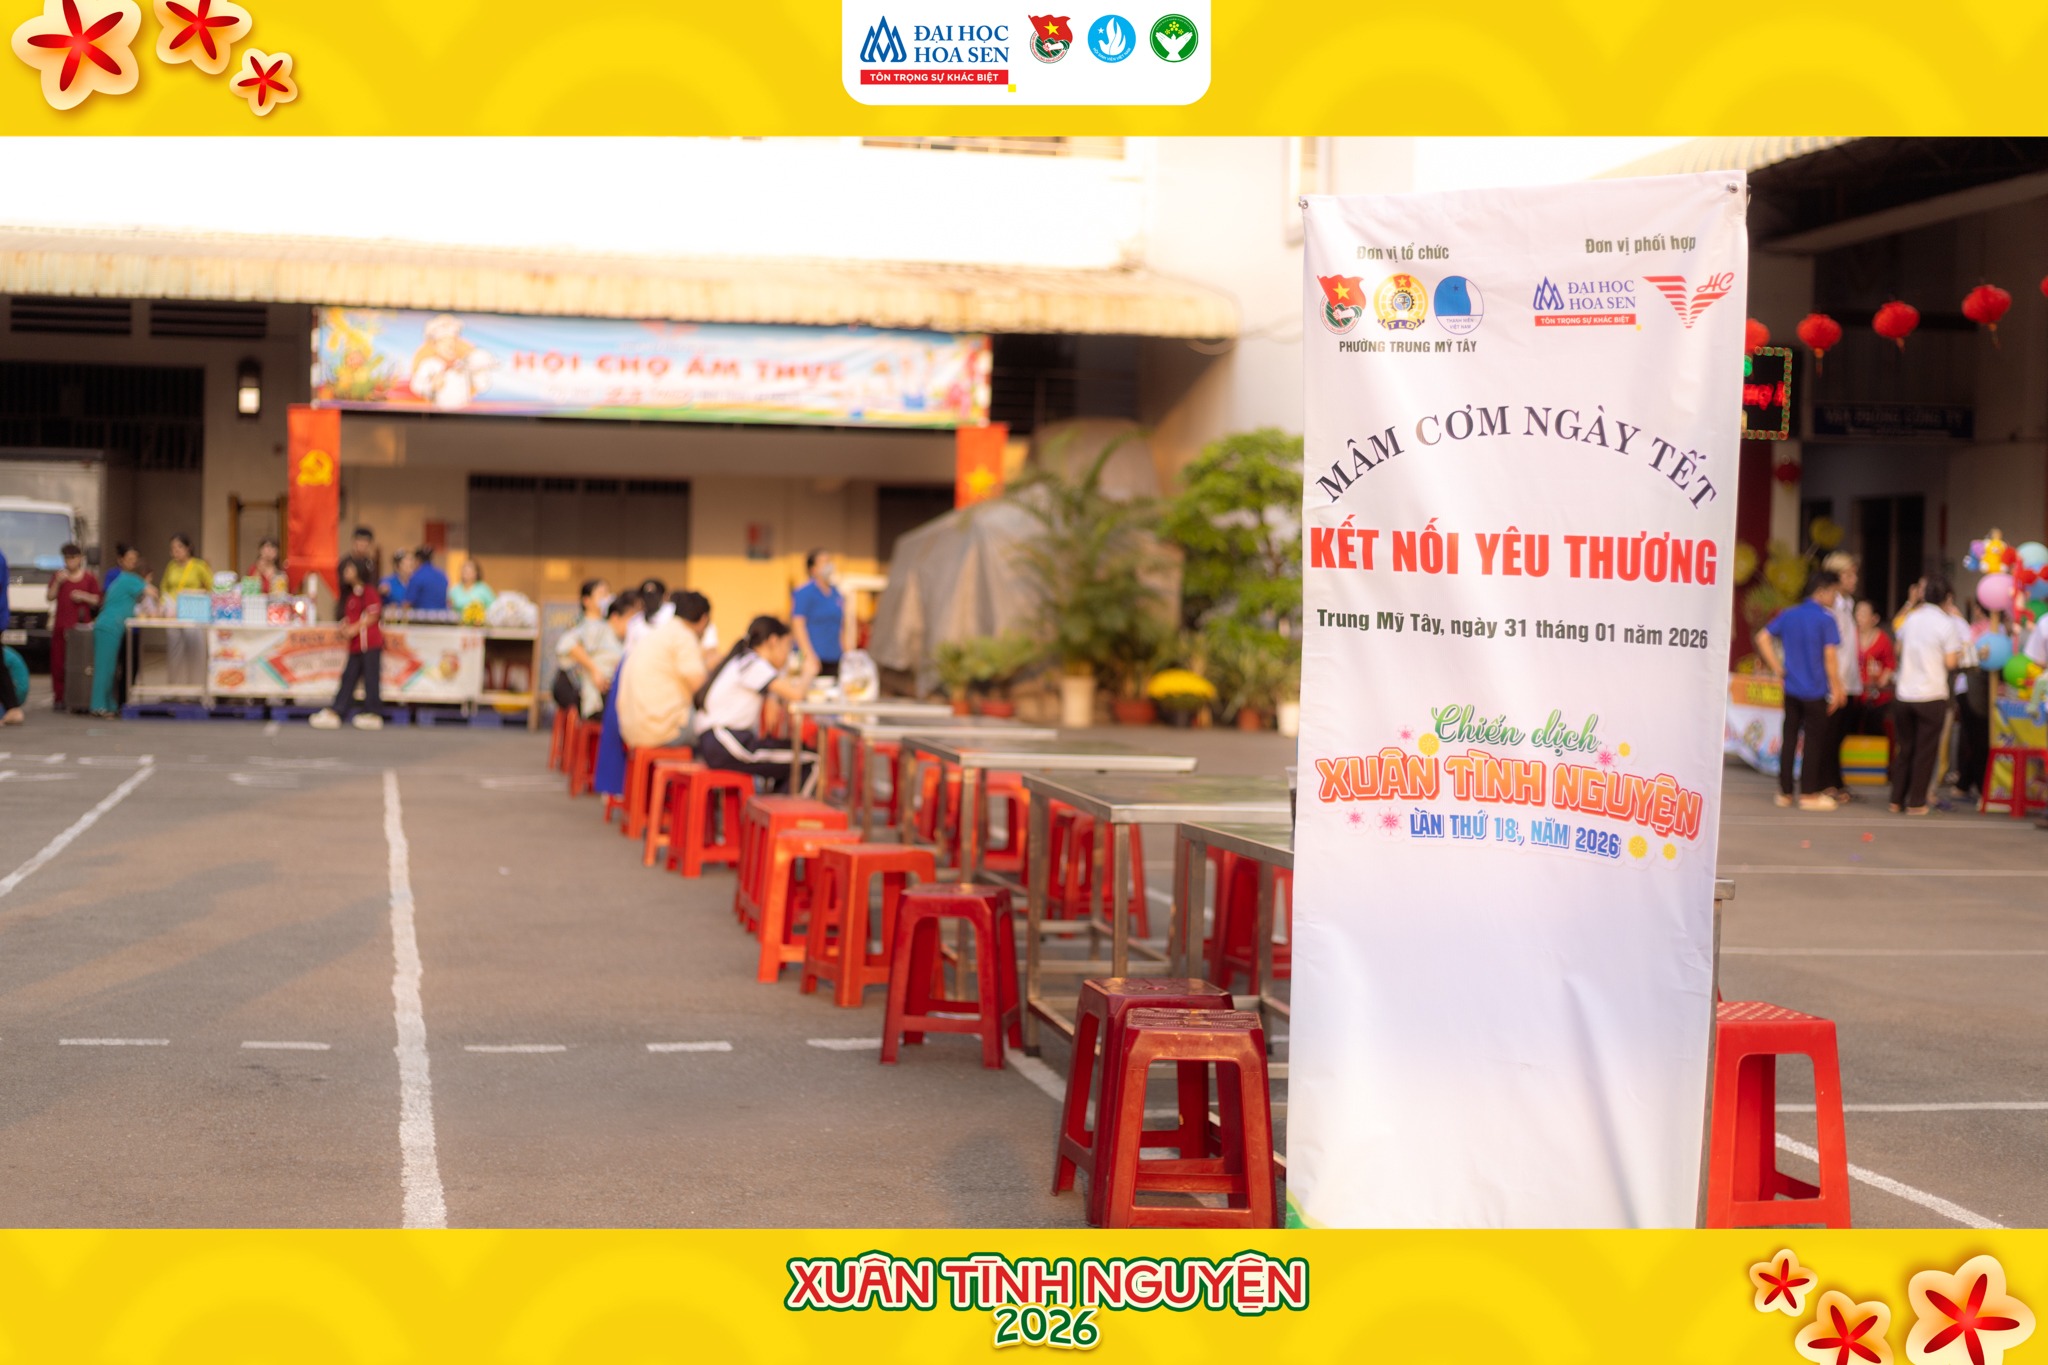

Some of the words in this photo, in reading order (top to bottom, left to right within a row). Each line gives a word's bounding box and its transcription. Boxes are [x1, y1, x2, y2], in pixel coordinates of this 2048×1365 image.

[1356, 245, 1383, 260] Đơn
[1386, 245, 1398, 263] vị
[1401, 242, 1415, 260] tổ
[1418, 244, 1450, 260] chức
[1585, 238, 1613, 253] Đơn
[1617, 237, 1630, 255] vị
[1634, 233, 1666, 254] phối
[1670, 235, 1696, 254] hợp
[1568, 281, 1594, 296] ĐẠI
[1599, 280, 1635, 295] HỌC
[1696, 272, 1735, 293] HC
[1569, 297, 1605, 310] HOA
[1607, 296, 1636, 309] SEN
[1540, 315, 1556, 325] TÔN
[1556, 316, 1581, 326] TRỌNG
[1582, 315, 1592, 325] SỰ
[1593, 315, 1612, 324] KHÁC
[1613, 315, 1630, 325] BIỆT
[1339, 338, 1385, 353] PHƯỜNG
[1389, 340, 1431, 353] TRUNG
[1434, 338, 1453, 353] MỸ
[1456, 338, 1477, 353] TÂY
[1315, 424, 1405, 503] MÂM
[1415, 404, 1511, 446] CƠM
[1523, 404, 1641, 456] NGÀY
[1648, 436, 1718, 510] TẾT
[1310, 514, 1379, 570] KẾT
[1392, 517, 1460, 575] NỐI
[1475, 526, 1550, 578] YÊU
[1563, 531, 1718, 586] THƯƠNG
[1317, 608, 1370, 631] Trung
[1376, 611, 1405, 633] Mỹ
[1410, 613, 1445, 636] Tây,
[1451, 616, 1498, 639] ngày
[1504, 618, 1527, 638] 31
[1535, 619, 1589, 643] tháng
[1595, 622, 1615, 643] 01
[1623, 624, 1663, 645] năm
[1668, 627, 1708, 650] 2026
[1431, 703, 1525, 746] Chiến
[1531, 708, 1600, 756] dịch
[1315, 746, 1441, 803] XUÂN
[1552, 762, 1703, 841] NGUYỆN
[1410, 807, 1445, 838] LẦN
[1449, 809, 1489, 839] THỨ
[1494, 816, 1525, 846] 18,
[1530, 816, 1570, 849] NĂM
[1575, 827, 1621, 859] 2026
